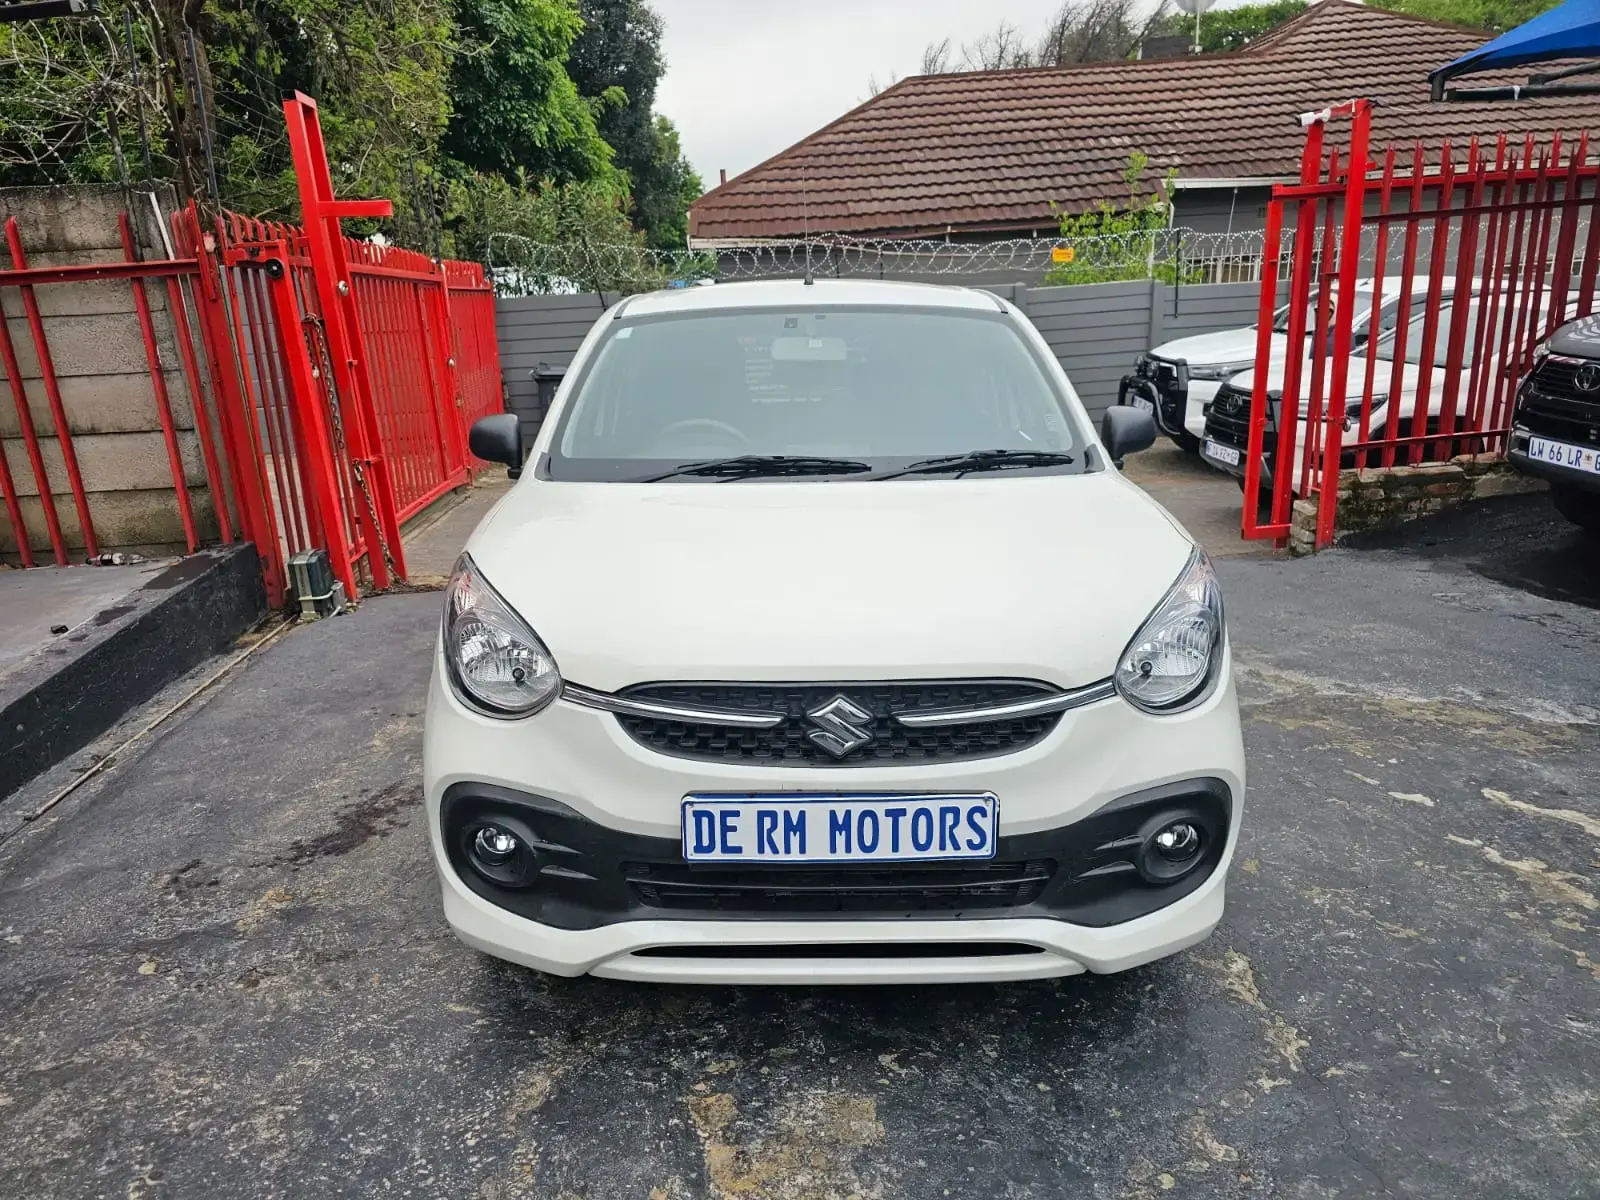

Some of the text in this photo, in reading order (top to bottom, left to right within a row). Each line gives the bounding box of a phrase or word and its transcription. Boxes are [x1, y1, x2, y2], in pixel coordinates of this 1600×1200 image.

[1531, 440, 1544, 457] LW
[1549, 444, 1562, 461] 66
[1568, 448, 1582, 467] LR
[692, 805, 988, 855] DE RM MOTORS
